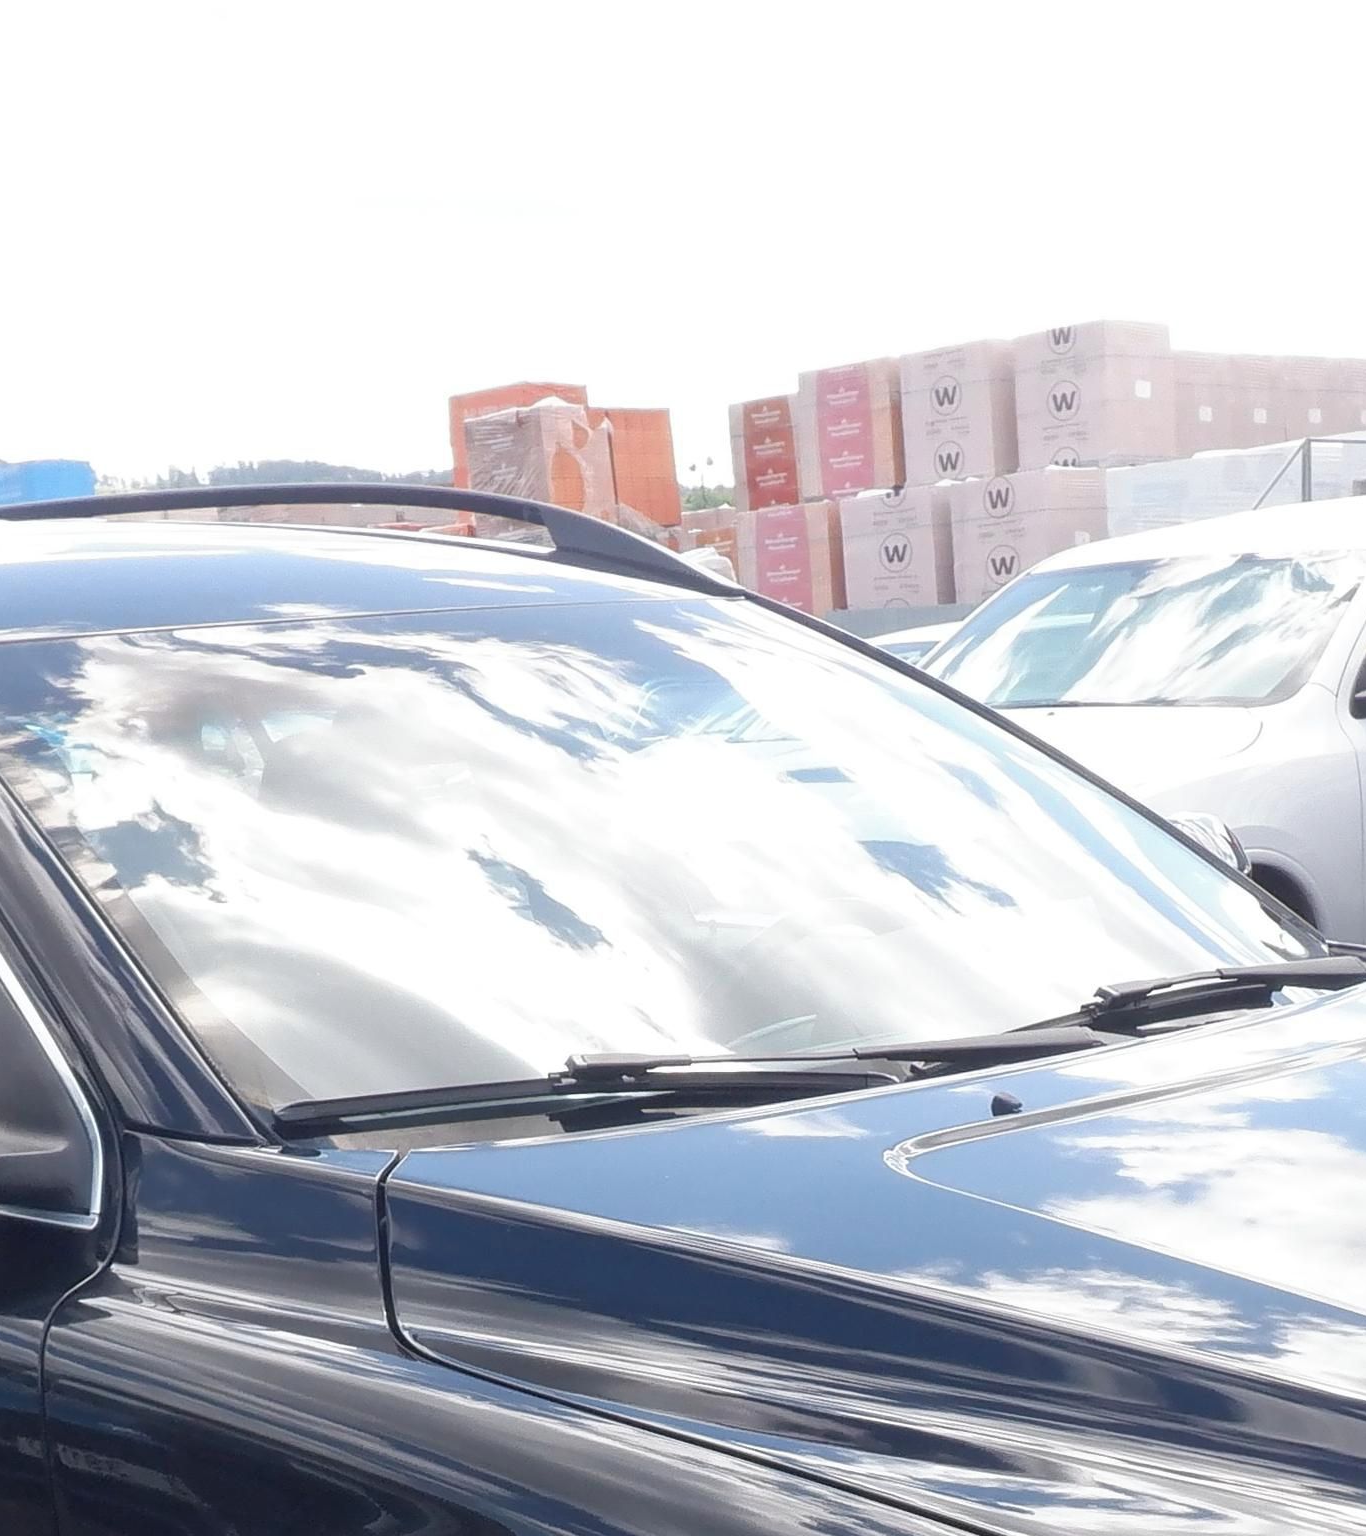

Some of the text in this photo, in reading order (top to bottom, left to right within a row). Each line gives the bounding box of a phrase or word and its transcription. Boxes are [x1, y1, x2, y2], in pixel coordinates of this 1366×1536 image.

[1050, 326, 1072, 347] W
[934, 385, 957, 407] W
[1051, 390, 1076, 412] W
[938, 450, 960, 473] W
[988, 487, 1010, 510] W
[884, 543, 908, 564] W
[991, 555, 1016, 577] W
